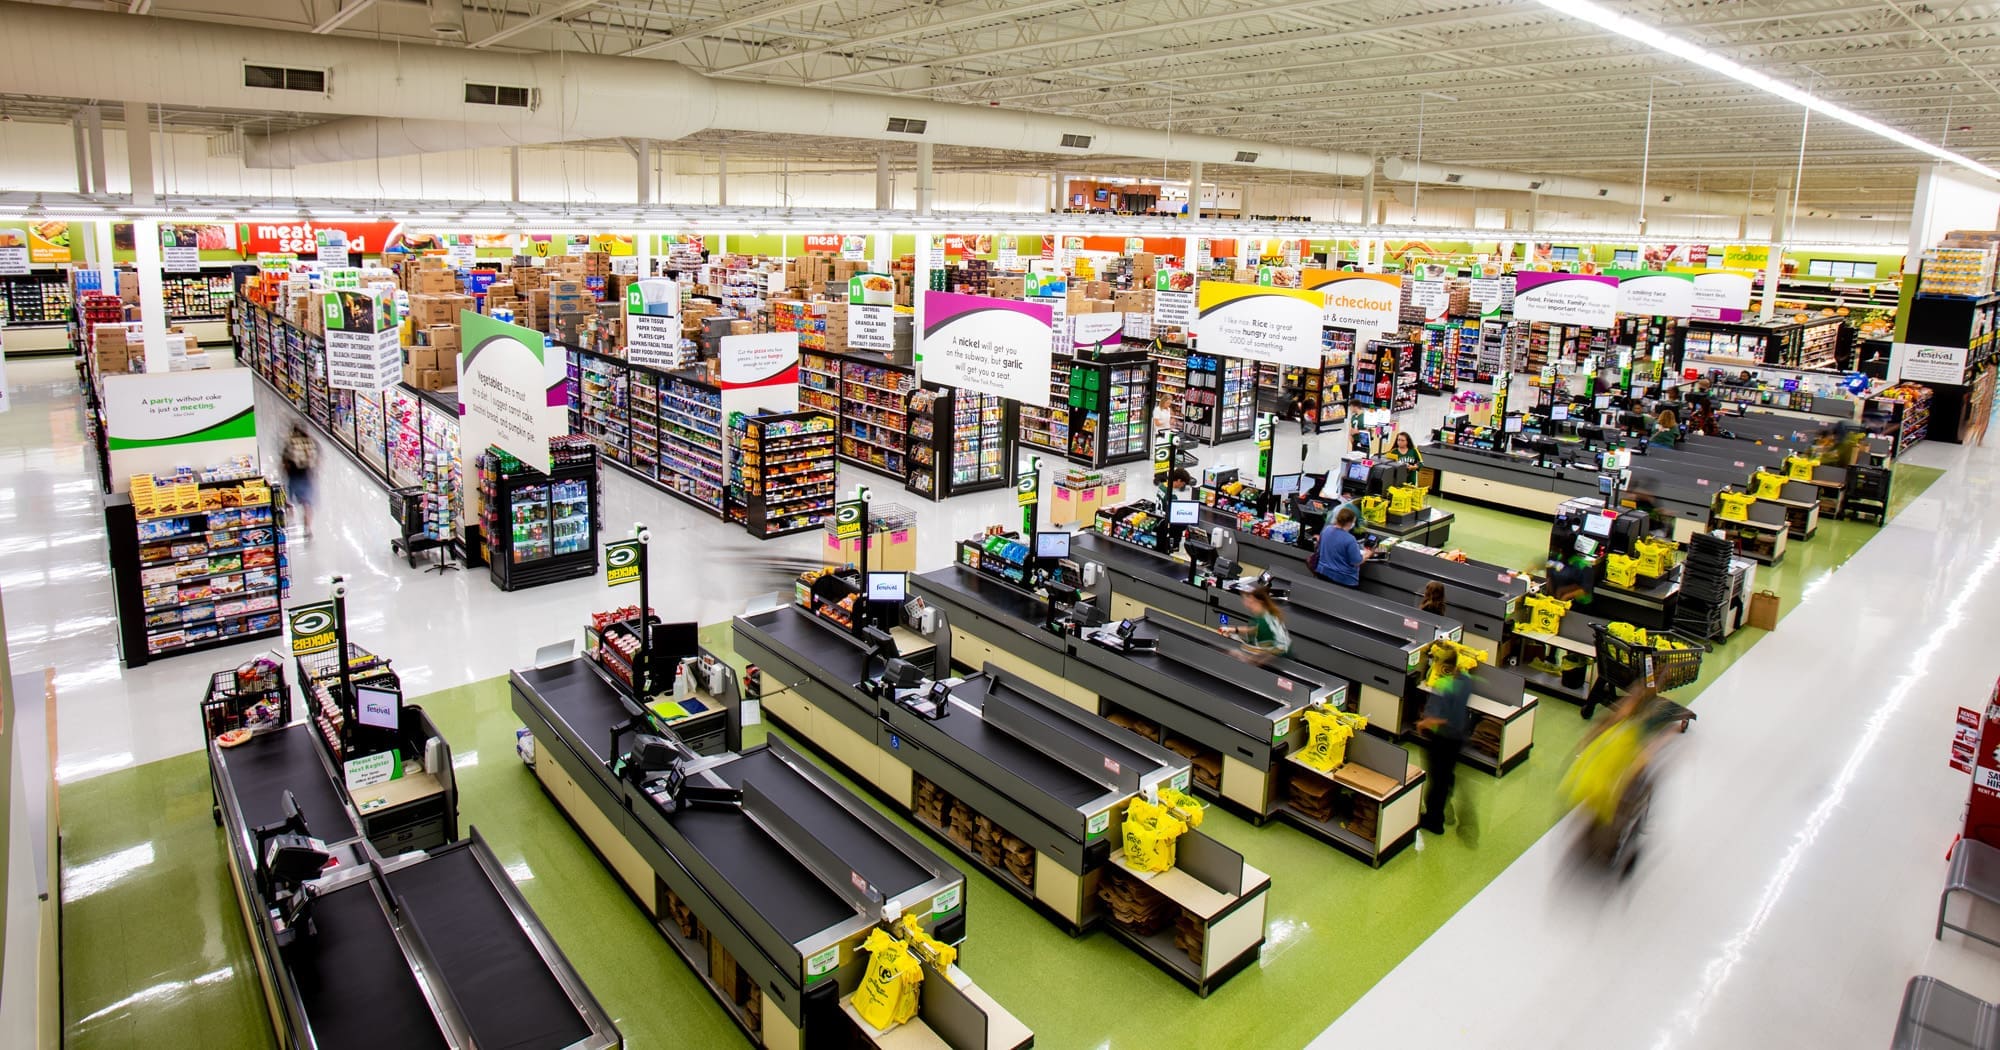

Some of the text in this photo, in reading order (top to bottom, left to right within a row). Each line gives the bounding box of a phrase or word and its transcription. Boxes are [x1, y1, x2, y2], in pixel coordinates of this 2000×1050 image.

[258, 220, 313, 239] meat
[808, 234, 838, 246] meat
[1160, 276, 1166, 285] 9
[1263, 273, 1268, 281] 8
[852, 285, 860, 296] 11
[1027, 280, 1037, 289] 10
[630, 292, 640, 305] 12
[1325, 292, 1393, 312] lf checkout
[327, 303, 339, 318] 13
[1547, 304, 1576, 312] important
[1252, 319, 1268, 328] Rice
[1276, 324, 1293, 332] great
[1331, 313, 1378, 326] & convenient
[1229, 335, 1245, 345] 2000
[1242, 327, 1266, 339] hungry
[1268, 332, 1280, 340] and
[1281, 334, 1297, 342] want
[350, 343, 374, 351] DETERGENT
[952, 336, 1017, 356] A nickel will get you
[946, 349, 953, 357] on
[954, 348, 963, 359] the
[990, 355, 1001, 365] but
[1002, 358, 1023, 370] garlic
[1917, 349, 1953, 360] festival
[360, 371, 374, 380] BULBS
[955, 362, 966, 371] will
[967, 365, 977, 375] get
[978, 367, 989, 378] you
[333, 379, 375, 389] NATURAL CLEANERS
[477, 369, 503, 392] Vegetables
[516, 390, 526, 402] must
[149, 396, 174, 406] party
[175, 394, 203, 402] without
[205, 393, 222, 401] cake
[157, 406, 170, 415] just
[493, 397, 508, 412] suggest
[508, 404, 521, 417] carrot
[500, 416, 508, 429] and
[508, 422, 526, 438] pumpkin
[1607, 456, 1616, 467] 8
[367, 704, 390, 715] festival
[349, 760, 390, 774] Next Register
[352, 756, 371, 766] Please
[1977, 786, 1990, 796] RENT
